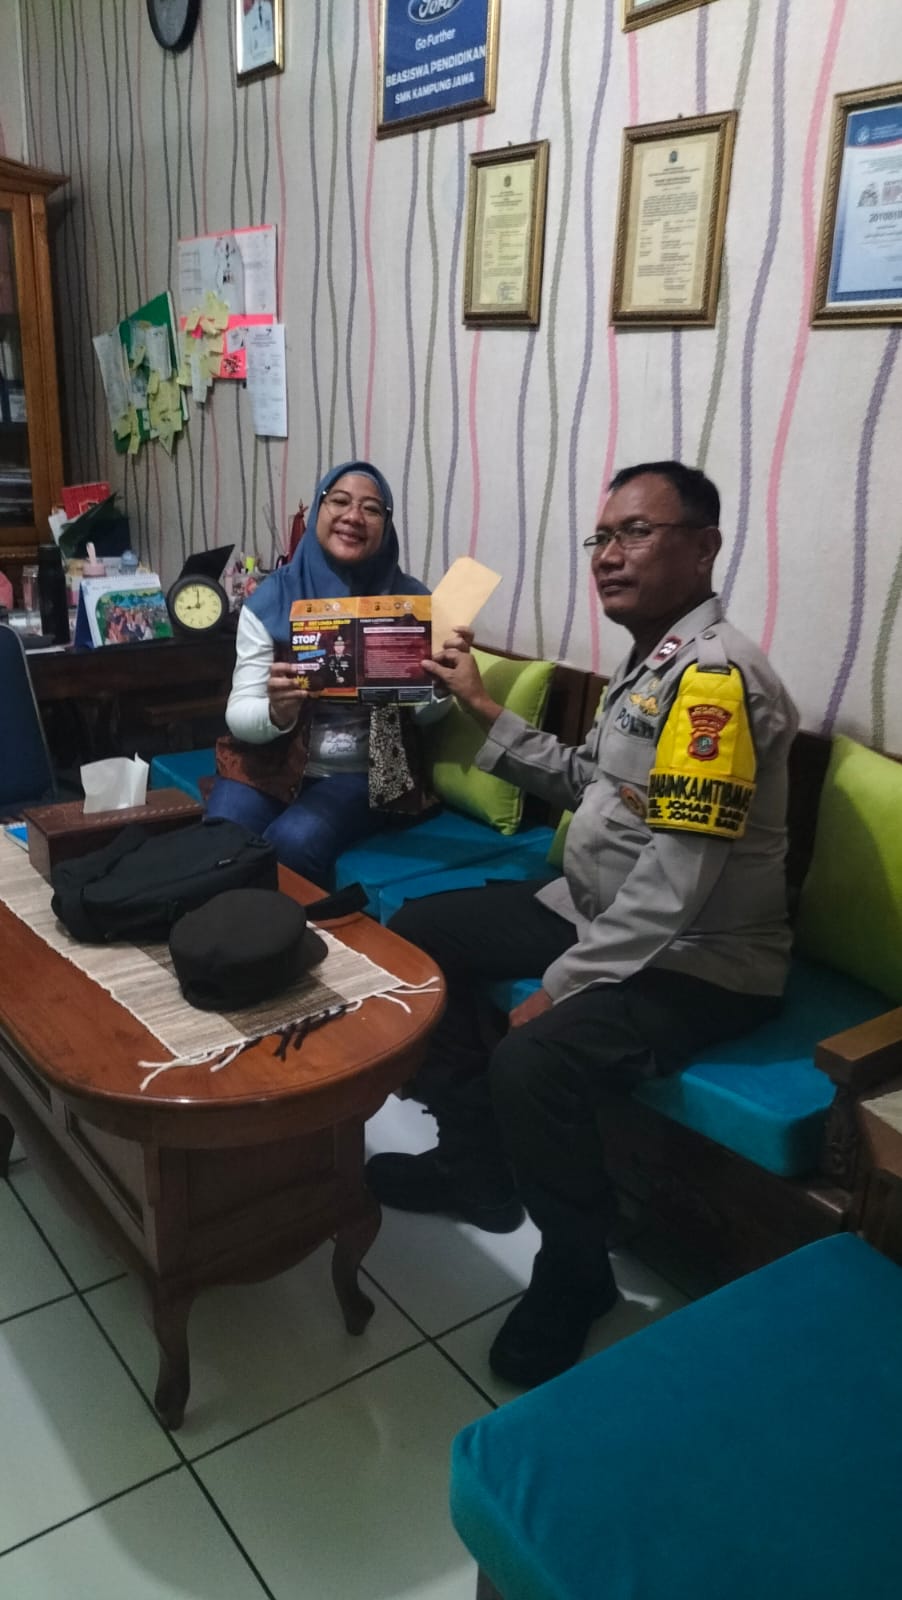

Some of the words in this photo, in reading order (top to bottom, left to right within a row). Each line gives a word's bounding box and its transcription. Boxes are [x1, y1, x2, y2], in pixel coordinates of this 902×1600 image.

[415, 38, 427, 51] Go
[427, 28, 456, 48] Further
[385, 64, 430, 88] BEASISWA
[430, 45, 486, 74] PENDIDIKAN
[394, 90, 412, 105] SMK
[412, 78, 452, 99] KAMPUNG
[452, 72, 475, 88] JAWA
[292, 632, 321, 646] STOP!
